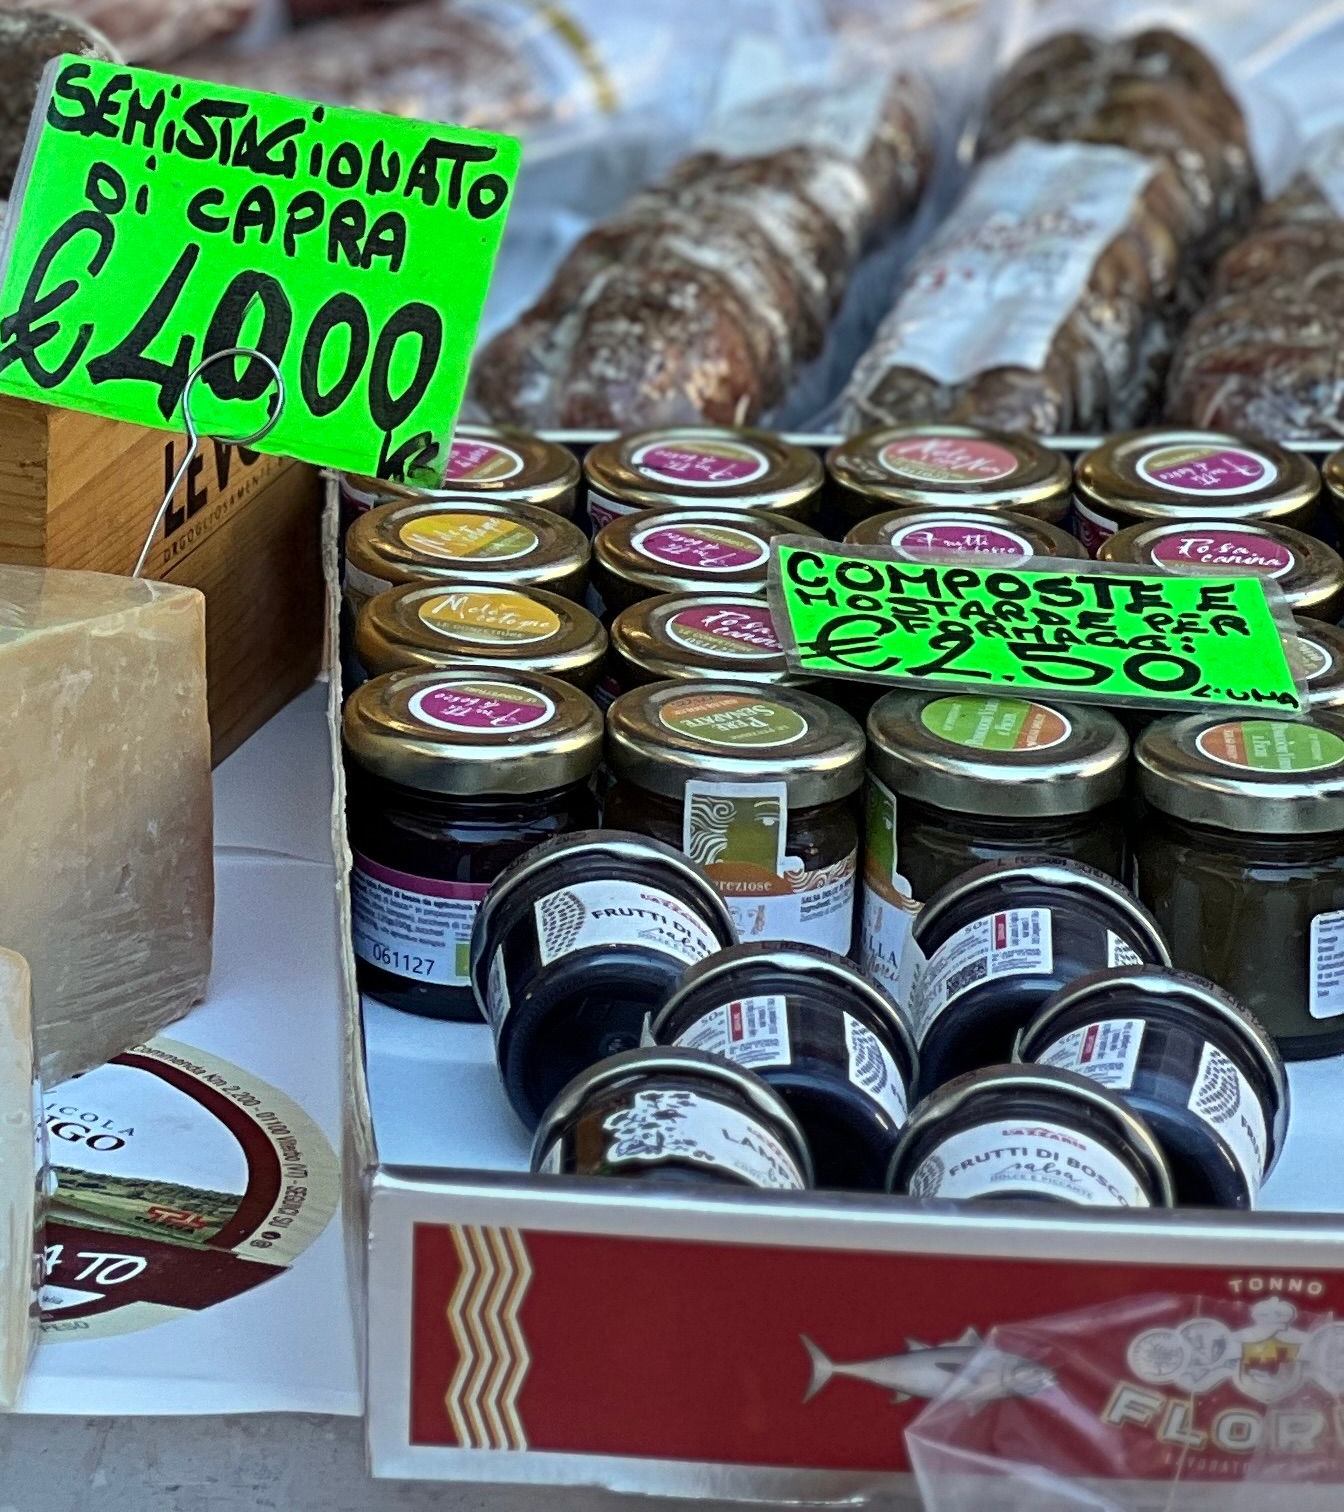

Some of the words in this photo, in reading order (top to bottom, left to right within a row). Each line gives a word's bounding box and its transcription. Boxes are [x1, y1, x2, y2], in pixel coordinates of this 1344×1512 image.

[46, 62, 510, 220] SEMISTAGIONATO
[85, 154, 160, 215] DI
[186, 185, 407, 273] CAPRA
[1200, 552, 1282, 566] canina
[786, 551, 1173, 615] COMPOSTE
[1196, 583, 1238, 612] E
[793, 587, 1118, 631] MOSTARDE
[1142, 611, 1251, 637] PER
[590, 906, 668, 925] FRUTTI
[672, 920, 692, 938] DI
[372, 943, 436, 976] 061127
[45, 1102, 135, 1137] ICOLA
[949, 1146, 1029, 1177] FRUTTI
[1035, 1147, 1061, 1162] DI
[1066, 1155, 1129, 1208] BOSCO
[43, 1243, 149, 1286] ATO
[1228, 1277, 1324, 1296] TONNO
[1098, 1379, 1344, 1455] FLOR
